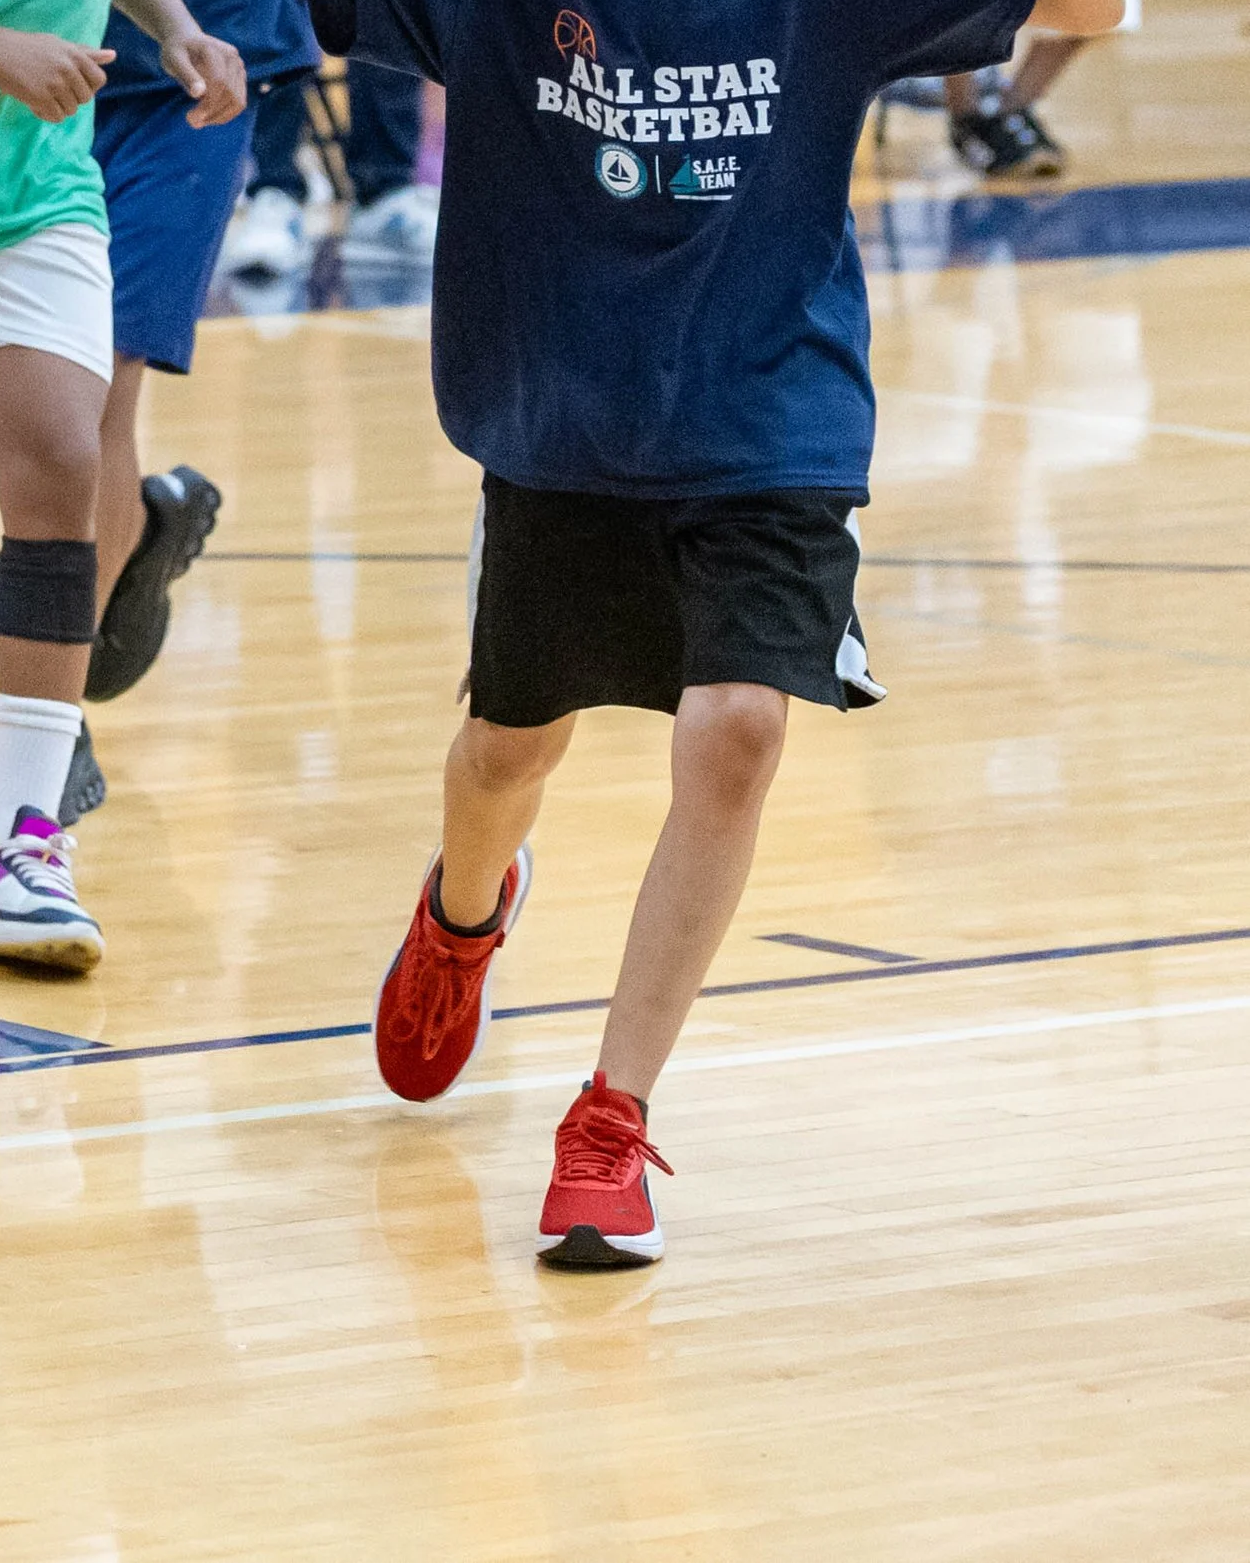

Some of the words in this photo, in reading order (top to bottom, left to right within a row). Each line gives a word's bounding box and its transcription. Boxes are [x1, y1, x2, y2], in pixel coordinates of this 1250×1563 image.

[569, 54, 644, 105] ALL
[653, 57, 781, 104] STAR
[692, 155, 742, 175] S.A.F.E.
[698, 172, 736, 190] TEAM
